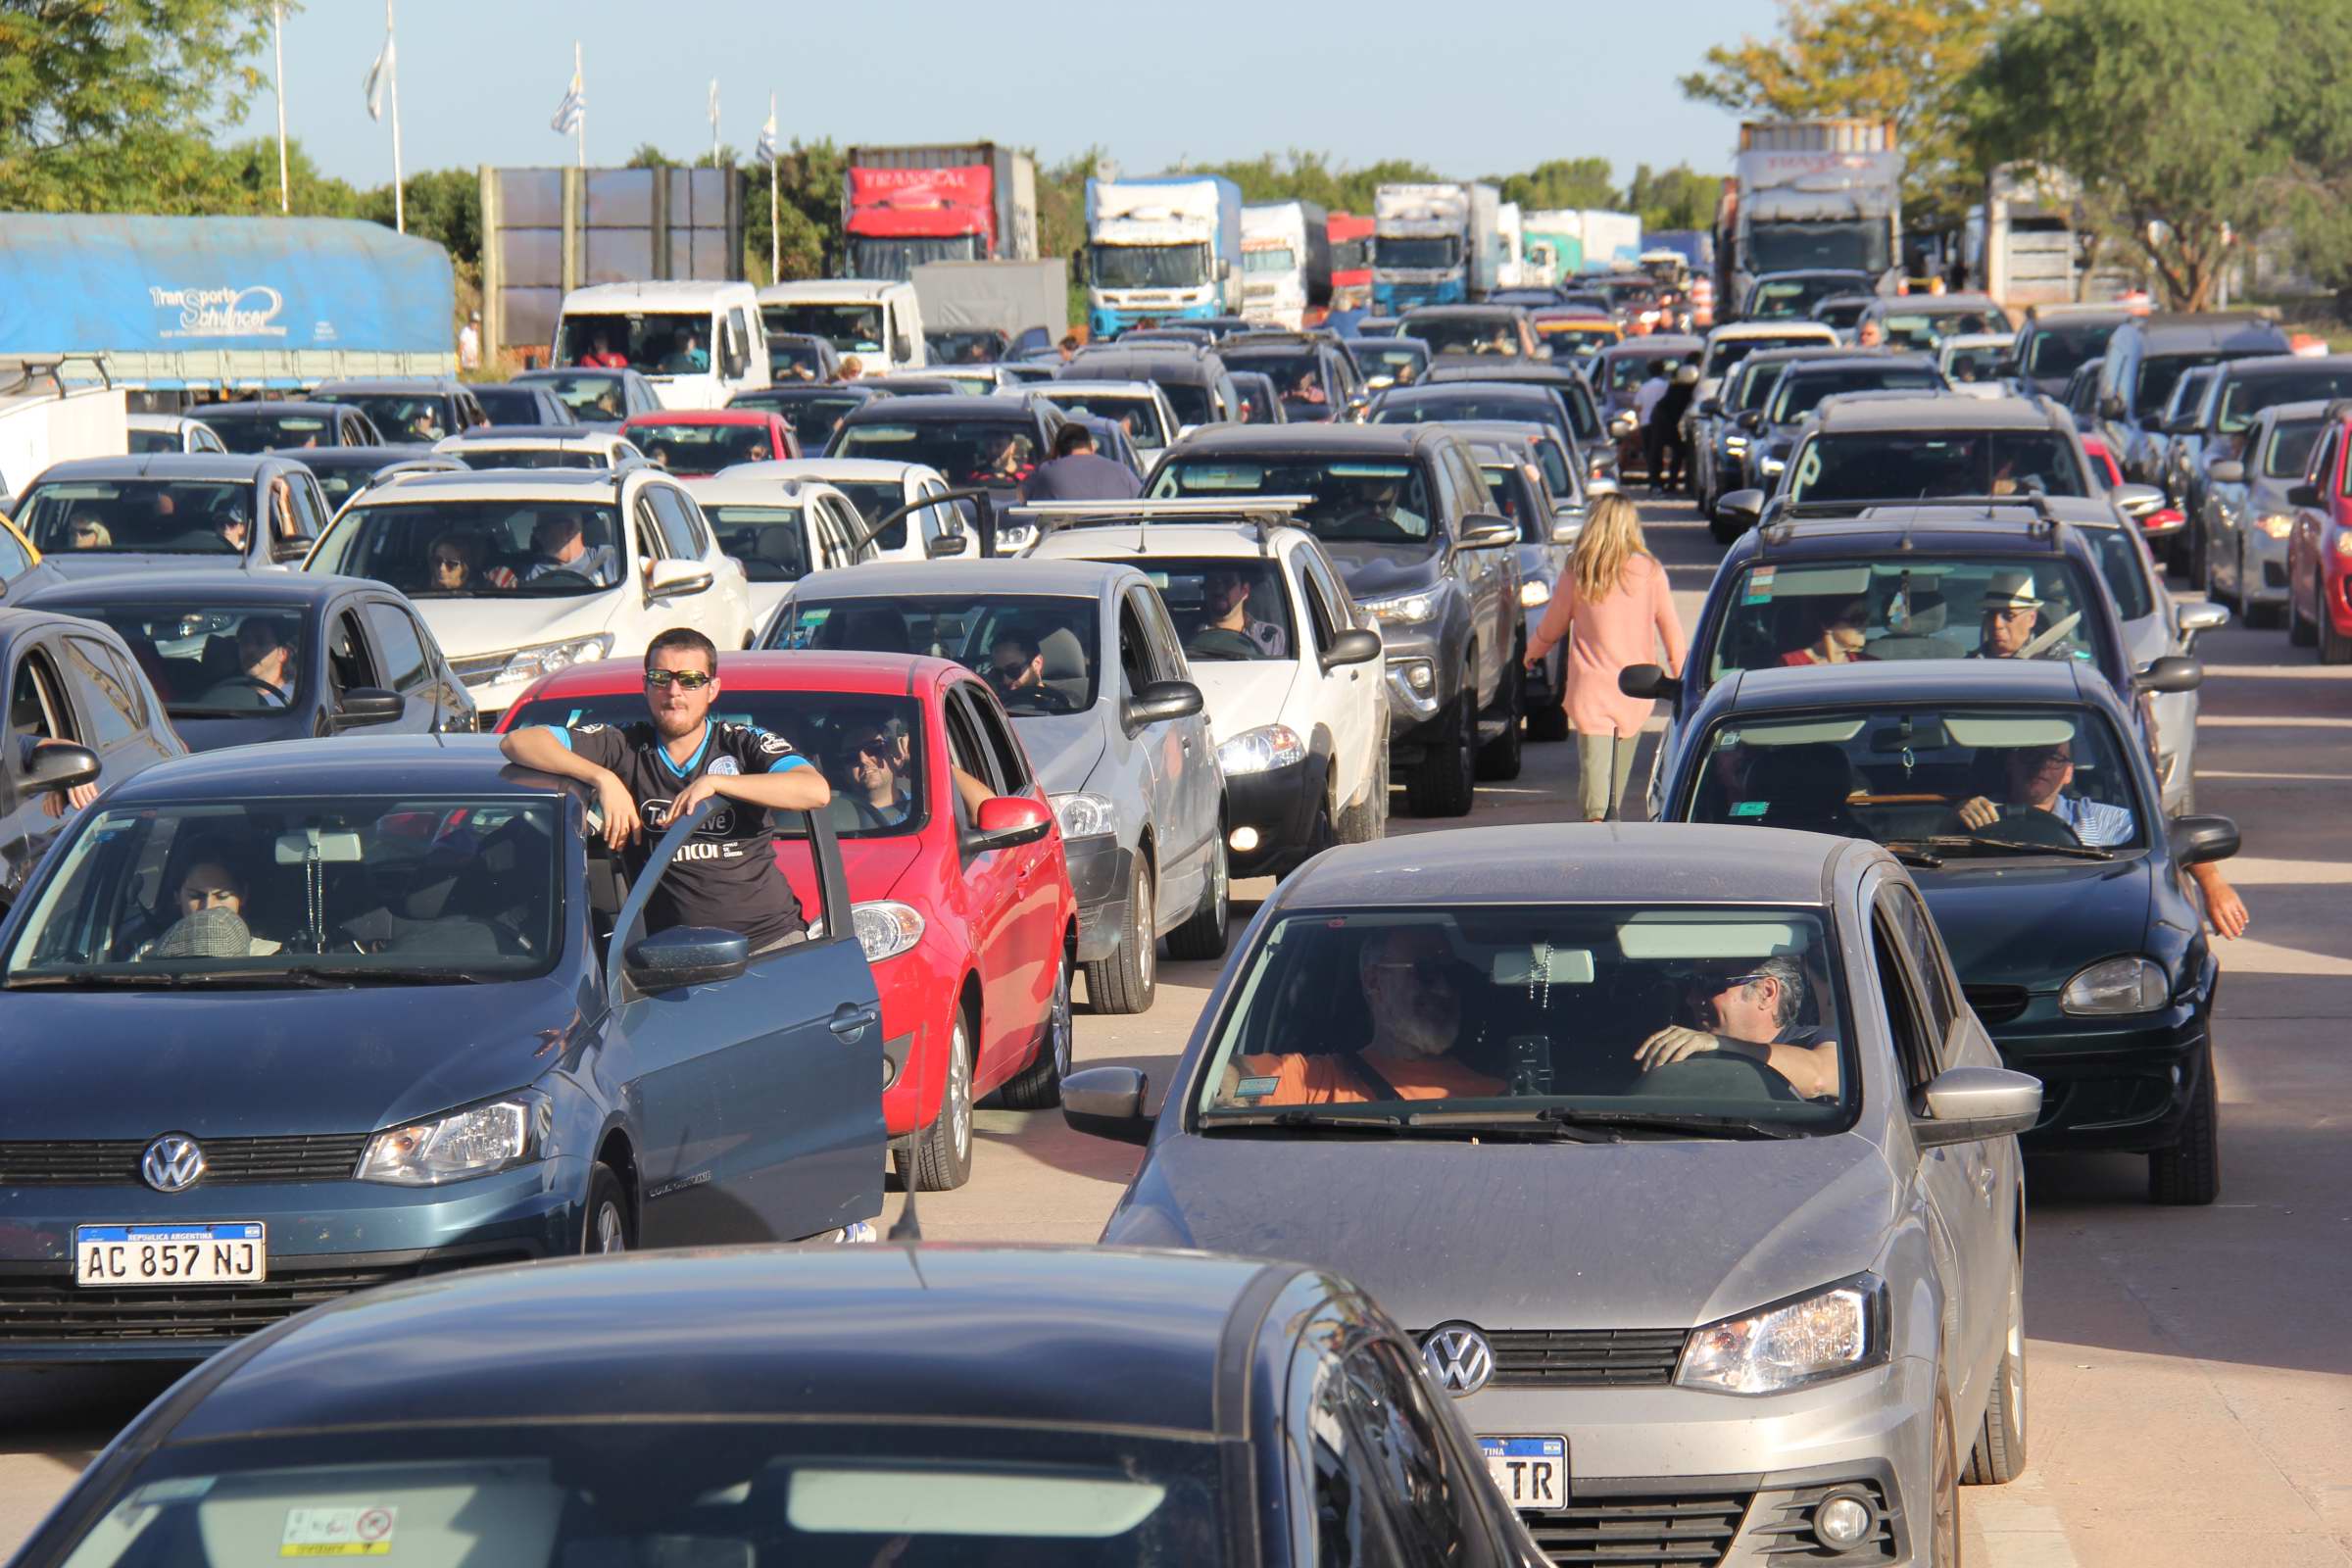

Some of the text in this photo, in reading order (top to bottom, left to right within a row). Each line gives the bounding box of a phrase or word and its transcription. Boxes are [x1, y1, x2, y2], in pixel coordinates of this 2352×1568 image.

[144, 1137, 202, 1192] VW
[171, 1231, 214, 1241] ARGENTINA
[87, 1244, 254, 1278] AC 857 NJ
[1506, 1461, 1553, 1500] TR
